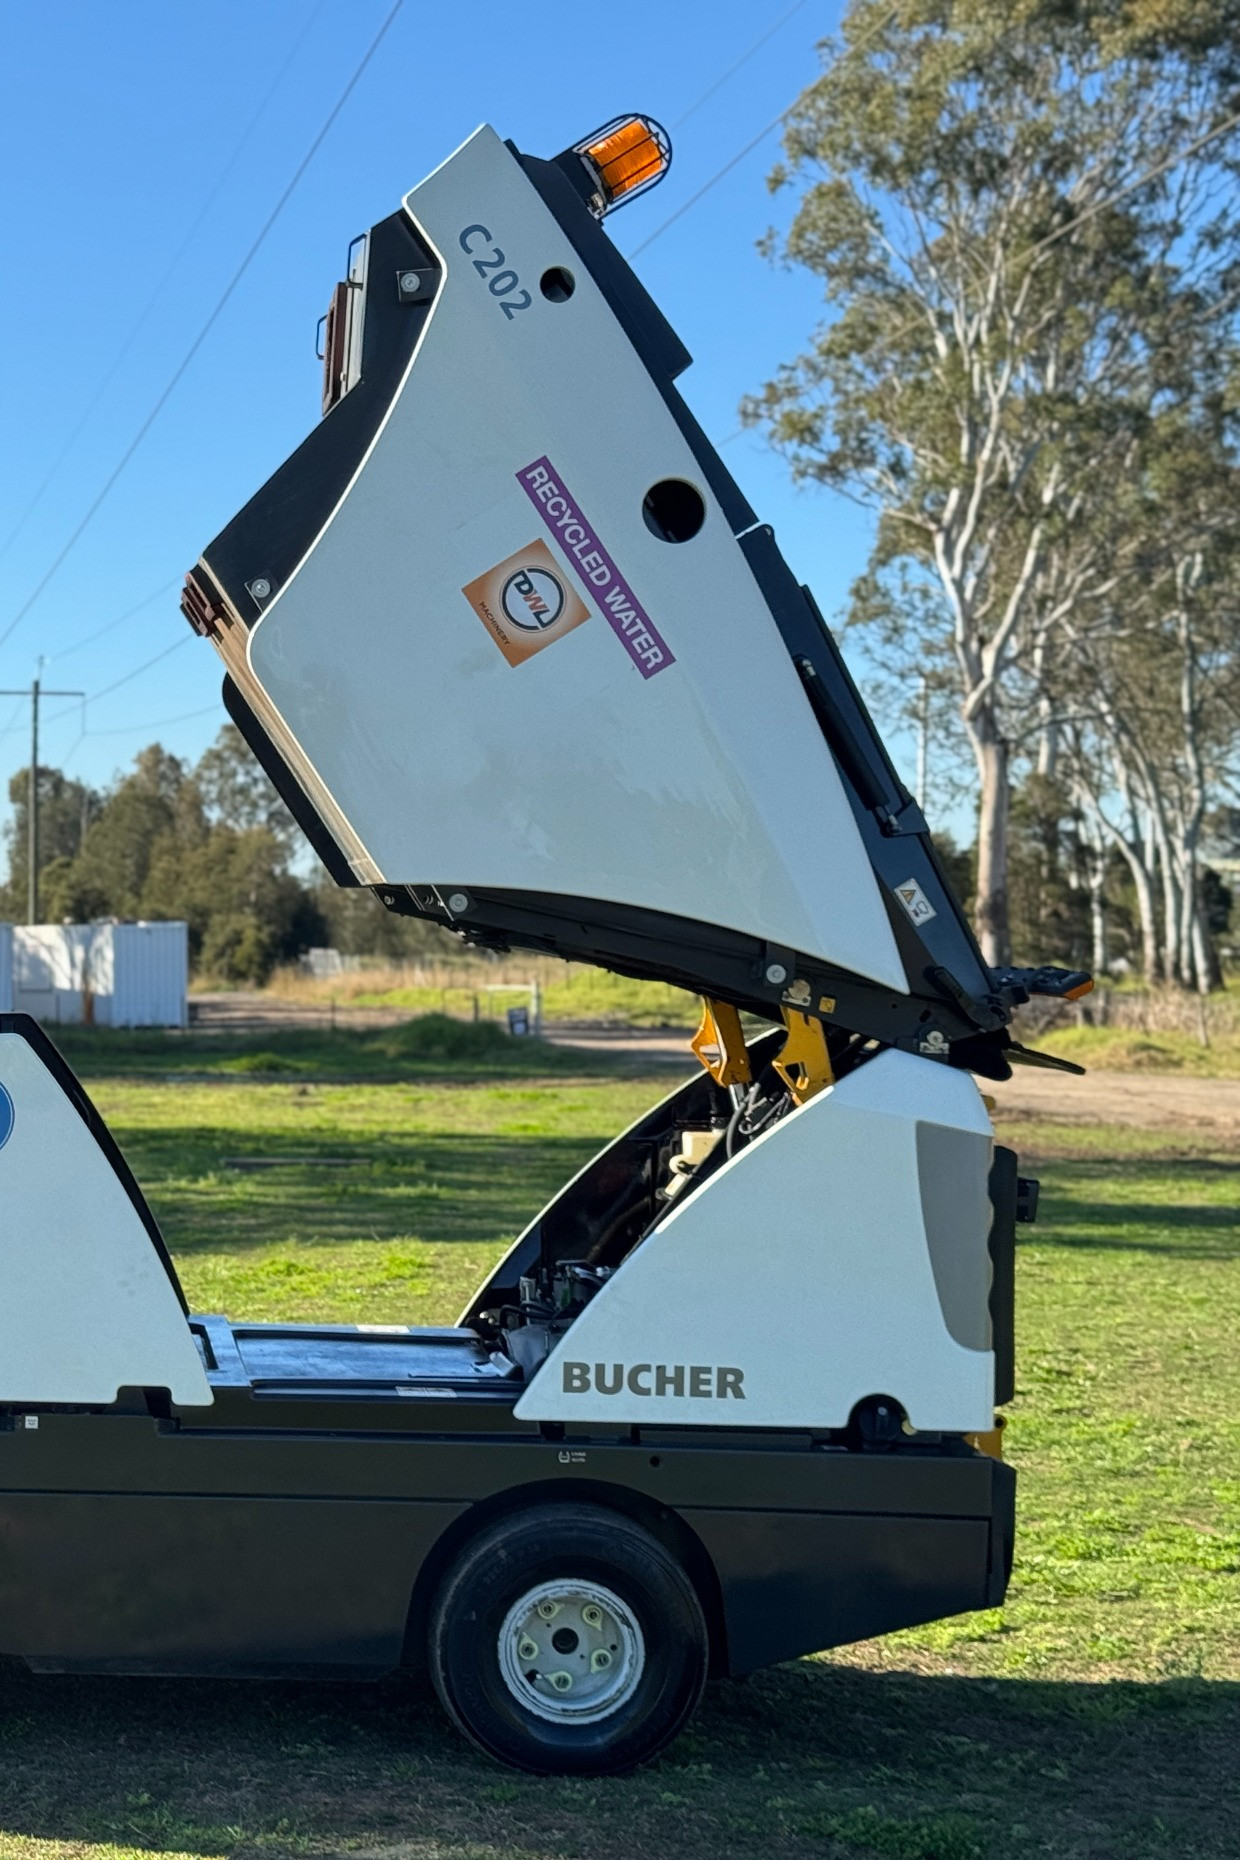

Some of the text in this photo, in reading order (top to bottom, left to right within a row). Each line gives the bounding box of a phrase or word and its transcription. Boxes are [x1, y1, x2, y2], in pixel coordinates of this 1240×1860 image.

[459, 224, 532, 320] C202
[525, 465, 664, 669] RECYCLED WATER
[479, 601, 511, 646] MACHINERY
[562, 1361, 746, 1399] BUCHER
